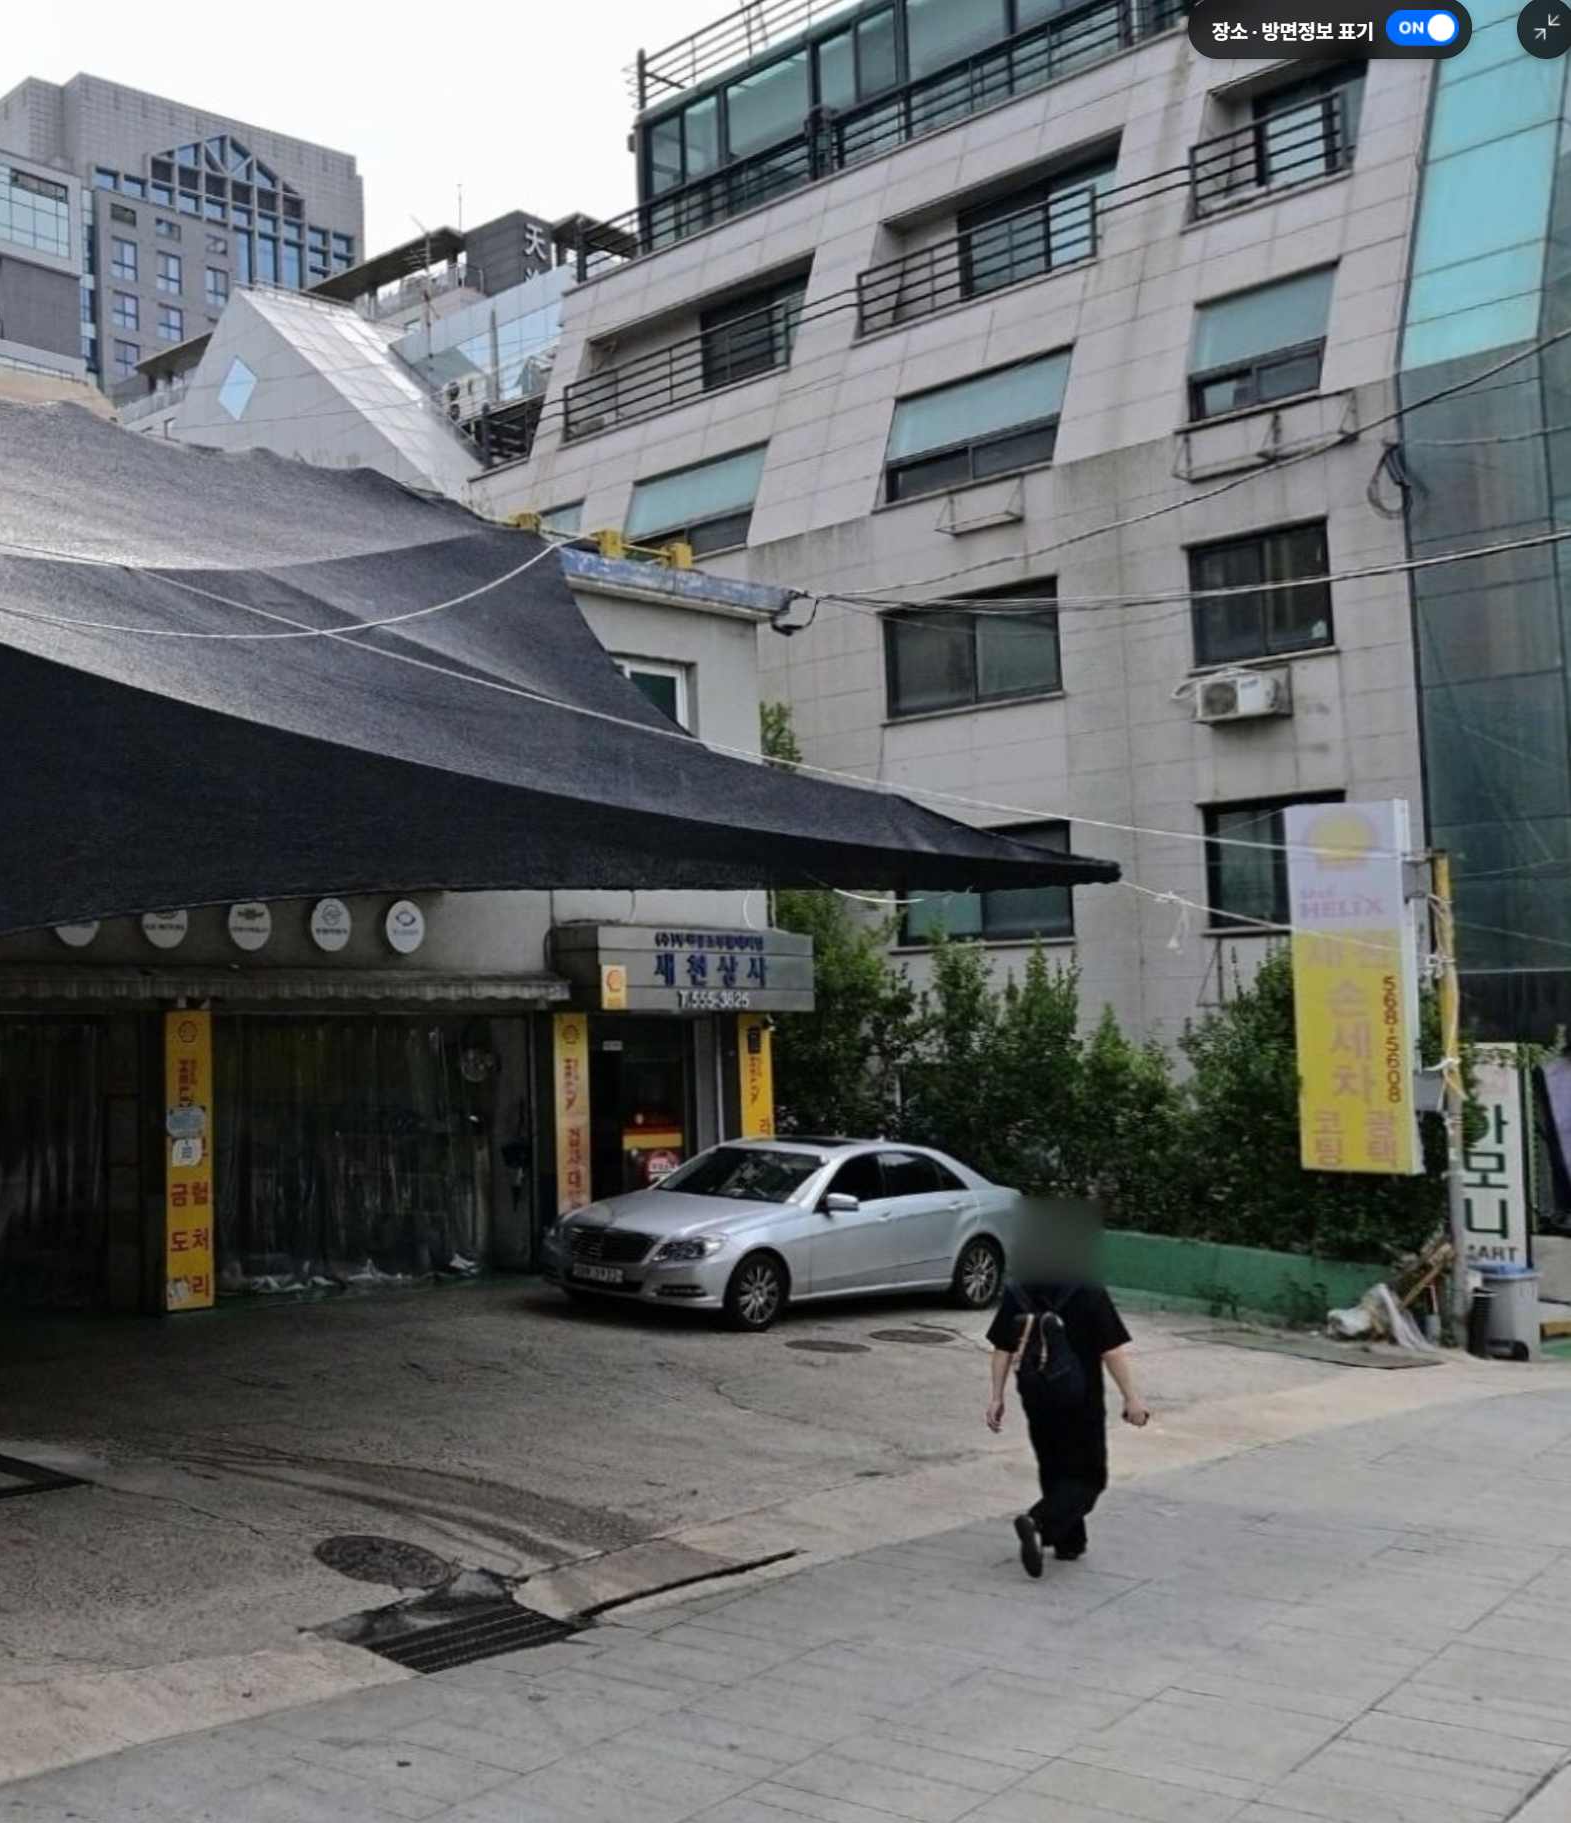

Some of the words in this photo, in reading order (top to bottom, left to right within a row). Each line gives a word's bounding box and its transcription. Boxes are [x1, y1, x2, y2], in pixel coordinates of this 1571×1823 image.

[1300, 895, 1385, 919] HELIX
[1326, 977, 1374, 1104] 손세차
[1383, 975, 1402, 1104] 568-5608
[1312, 1109, 1343, 1167] 코팅
[1365, 1109, 1398, 1168] 광택
